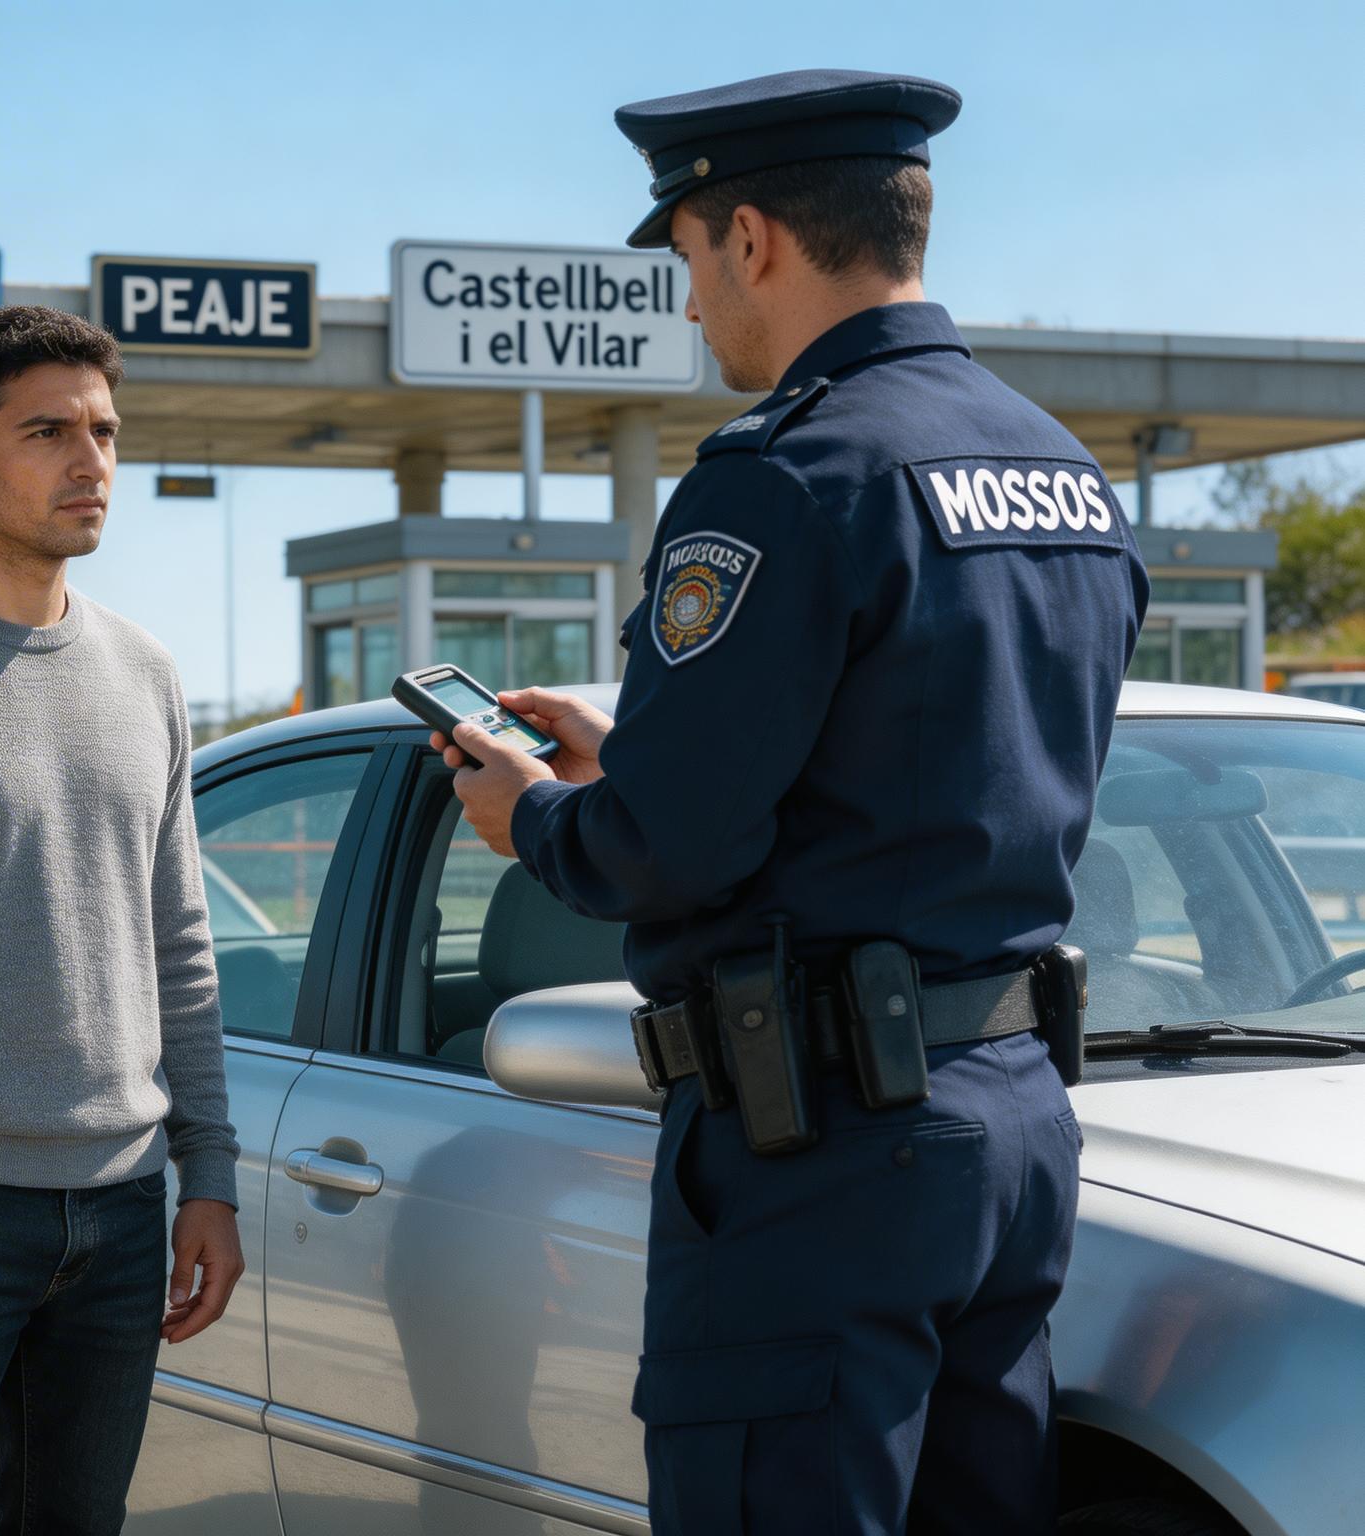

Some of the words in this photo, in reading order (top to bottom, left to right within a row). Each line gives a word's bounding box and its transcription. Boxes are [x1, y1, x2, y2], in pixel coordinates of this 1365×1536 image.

[121, 275, 293, 337] PEAJE
[422, 259, 675, 313] Castellbell
[460, 320, 471, 365] i
[488, 320, 528, 365] el
[543, 321, 649, 368] Vilar
[929, 468, 1112, 534] MOSSOS
